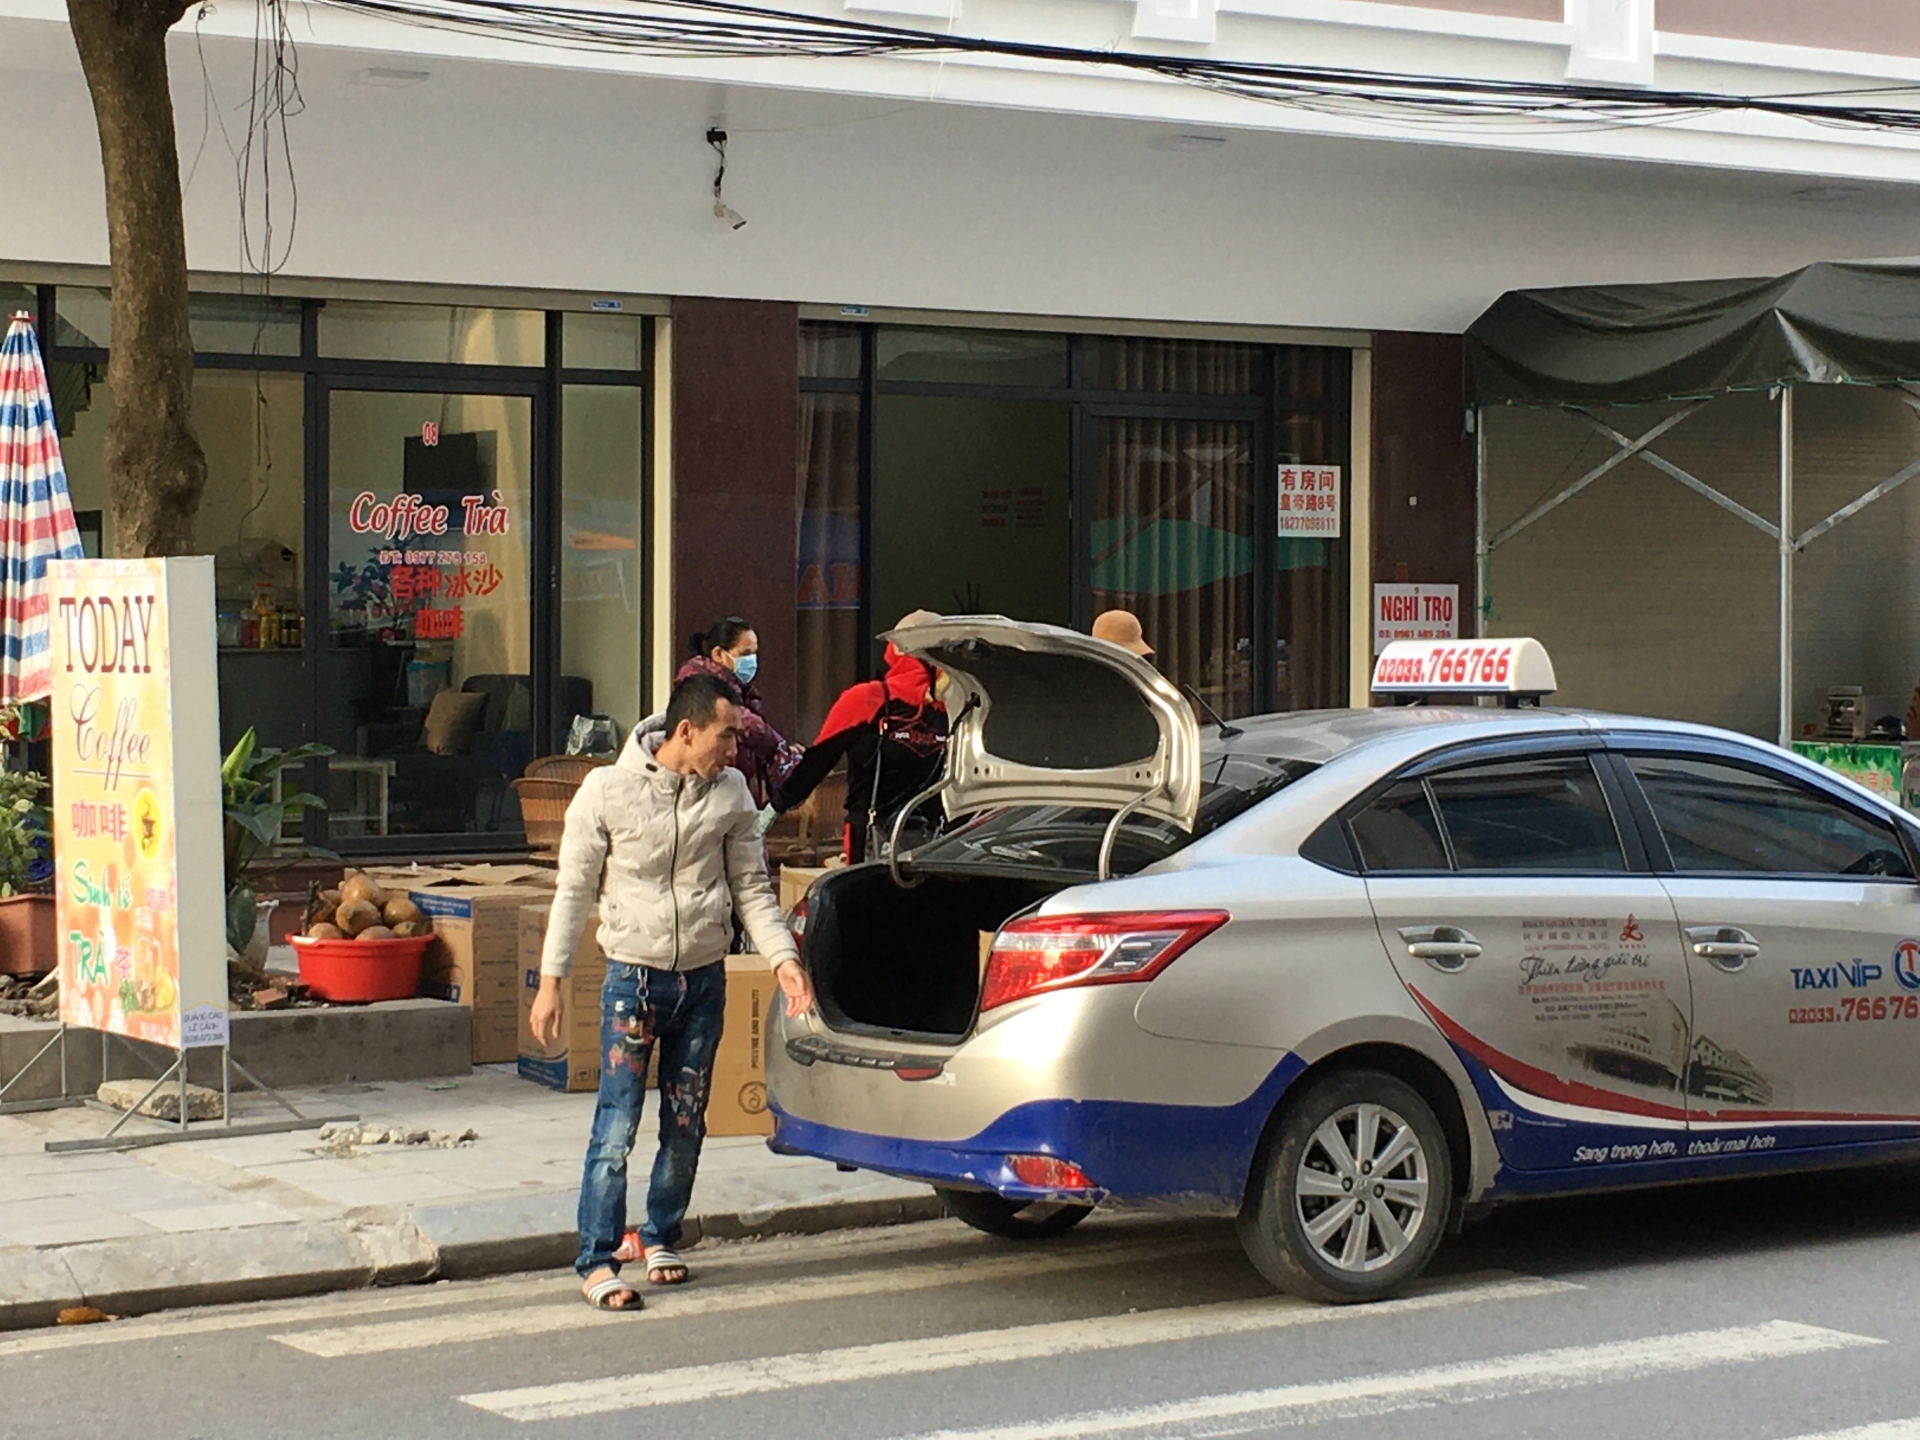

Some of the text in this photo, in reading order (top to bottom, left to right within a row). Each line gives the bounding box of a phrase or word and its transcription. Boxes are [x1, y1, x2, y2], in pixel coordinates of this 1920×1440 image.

[1281, 469, 1335, 491] 有房间
[351, 490, 509, 539] Coffee Trà
[389, 564, 503, 599] 各种冰沙
[1380, 587, 1452, 628] NGHỈ TRỌ
[59, 595, 154, 673] TODAY
[1377, 647, 1512, 683] 02033.766766
[70, 683, 150, 791] Coffee
[71, 799, 127, 842] 咖啡
[70, 860, 111, 907] Sinh
[69, 929, 109, 986] TRÀ
[1790, 958, 1882, 990] TAXI VIP
[1788, 995, 1920, 1024] 02033.76676
[1573, 1146, 1608, 1162] Sang
[1610, 1143, 1647, 1160] trọng
